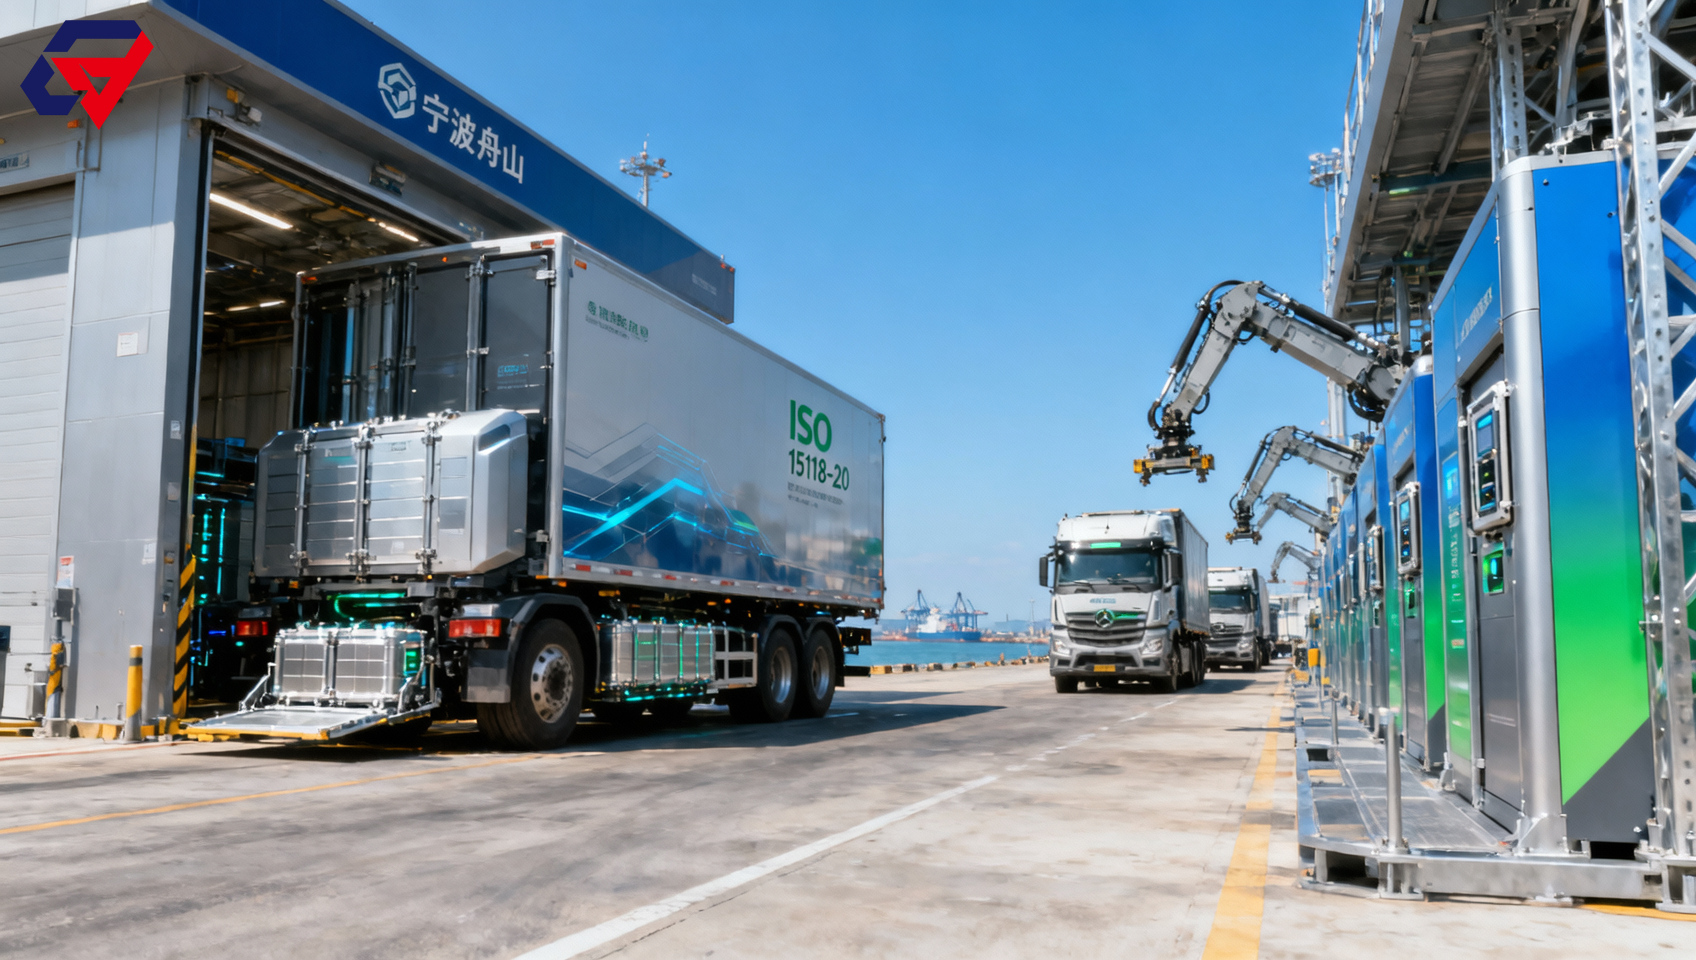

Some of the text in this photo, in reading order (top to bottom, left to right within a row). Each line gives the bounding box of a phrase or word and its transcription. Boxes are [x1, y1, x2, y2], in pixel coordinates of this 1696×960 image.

[422, 93, 524, 184] 宁波舟山
[789, 399, 832, 453] ISO
[788, 448, 850, 491] 15118-20
